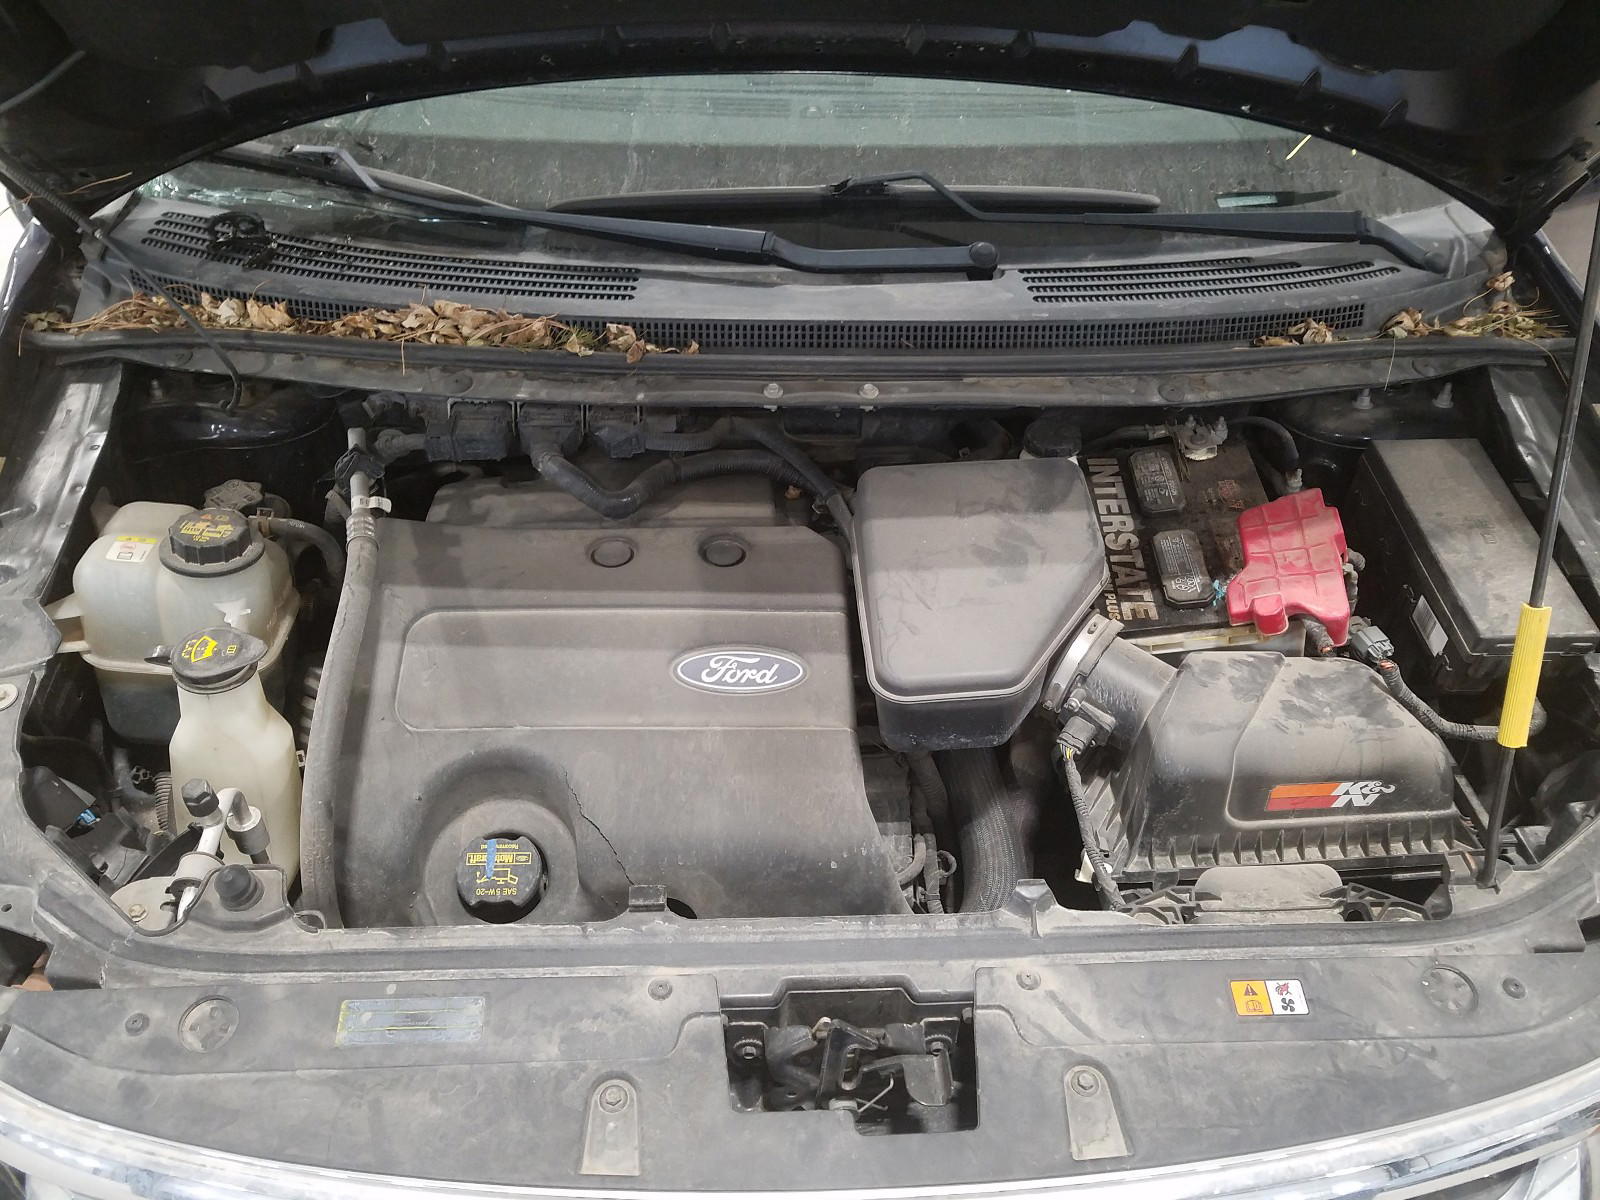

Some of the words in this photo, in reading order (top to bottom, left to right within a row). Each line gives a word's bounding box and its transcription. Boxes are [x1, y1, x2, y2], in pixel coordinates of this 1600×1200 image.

[1086, 457, 1159, 621] INTERSTATE
[1103, 592, 1121, 620] PLUS
[701, 655, 779, 684] Ford
[1330, 780, 1396, 808] K&N
[469, 854, 513, 864] Motraft
[475, 887, 501, 896] 5W-20
[502, 887, 517, 896] SAE
